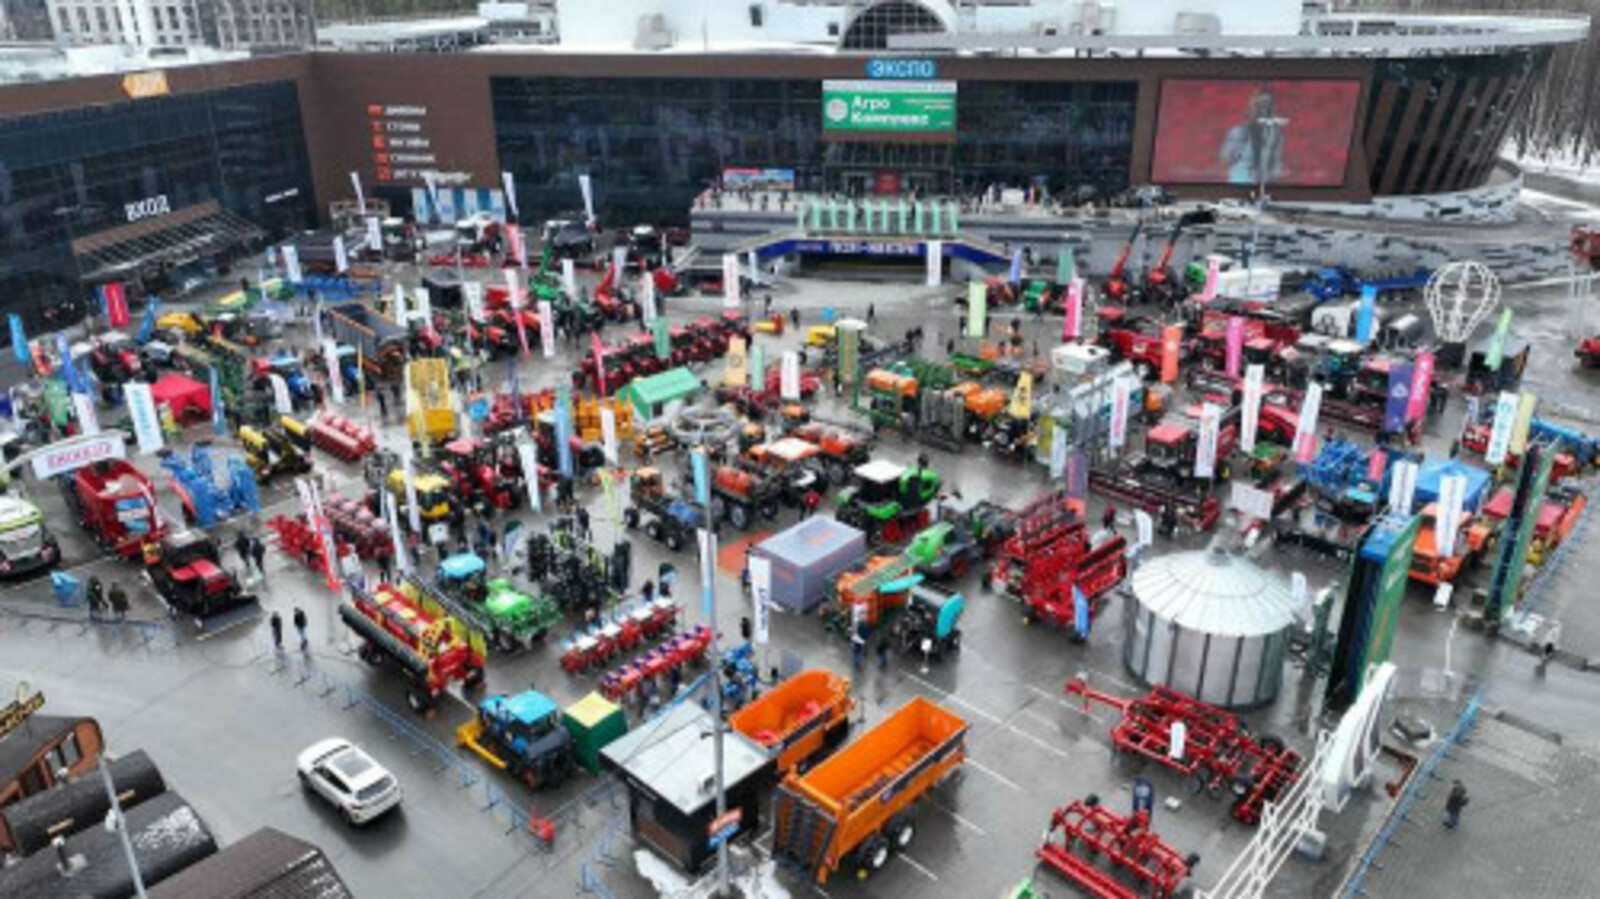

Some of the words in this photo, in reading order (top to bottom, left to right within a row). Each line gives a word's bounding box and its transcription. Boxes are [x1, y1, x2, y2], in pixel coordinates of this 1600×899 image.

[871, 60, 934, 77] ЭКСПО
[851, 96, 890, 111] Агро
[124, 194, 171, 221] ВХОД
